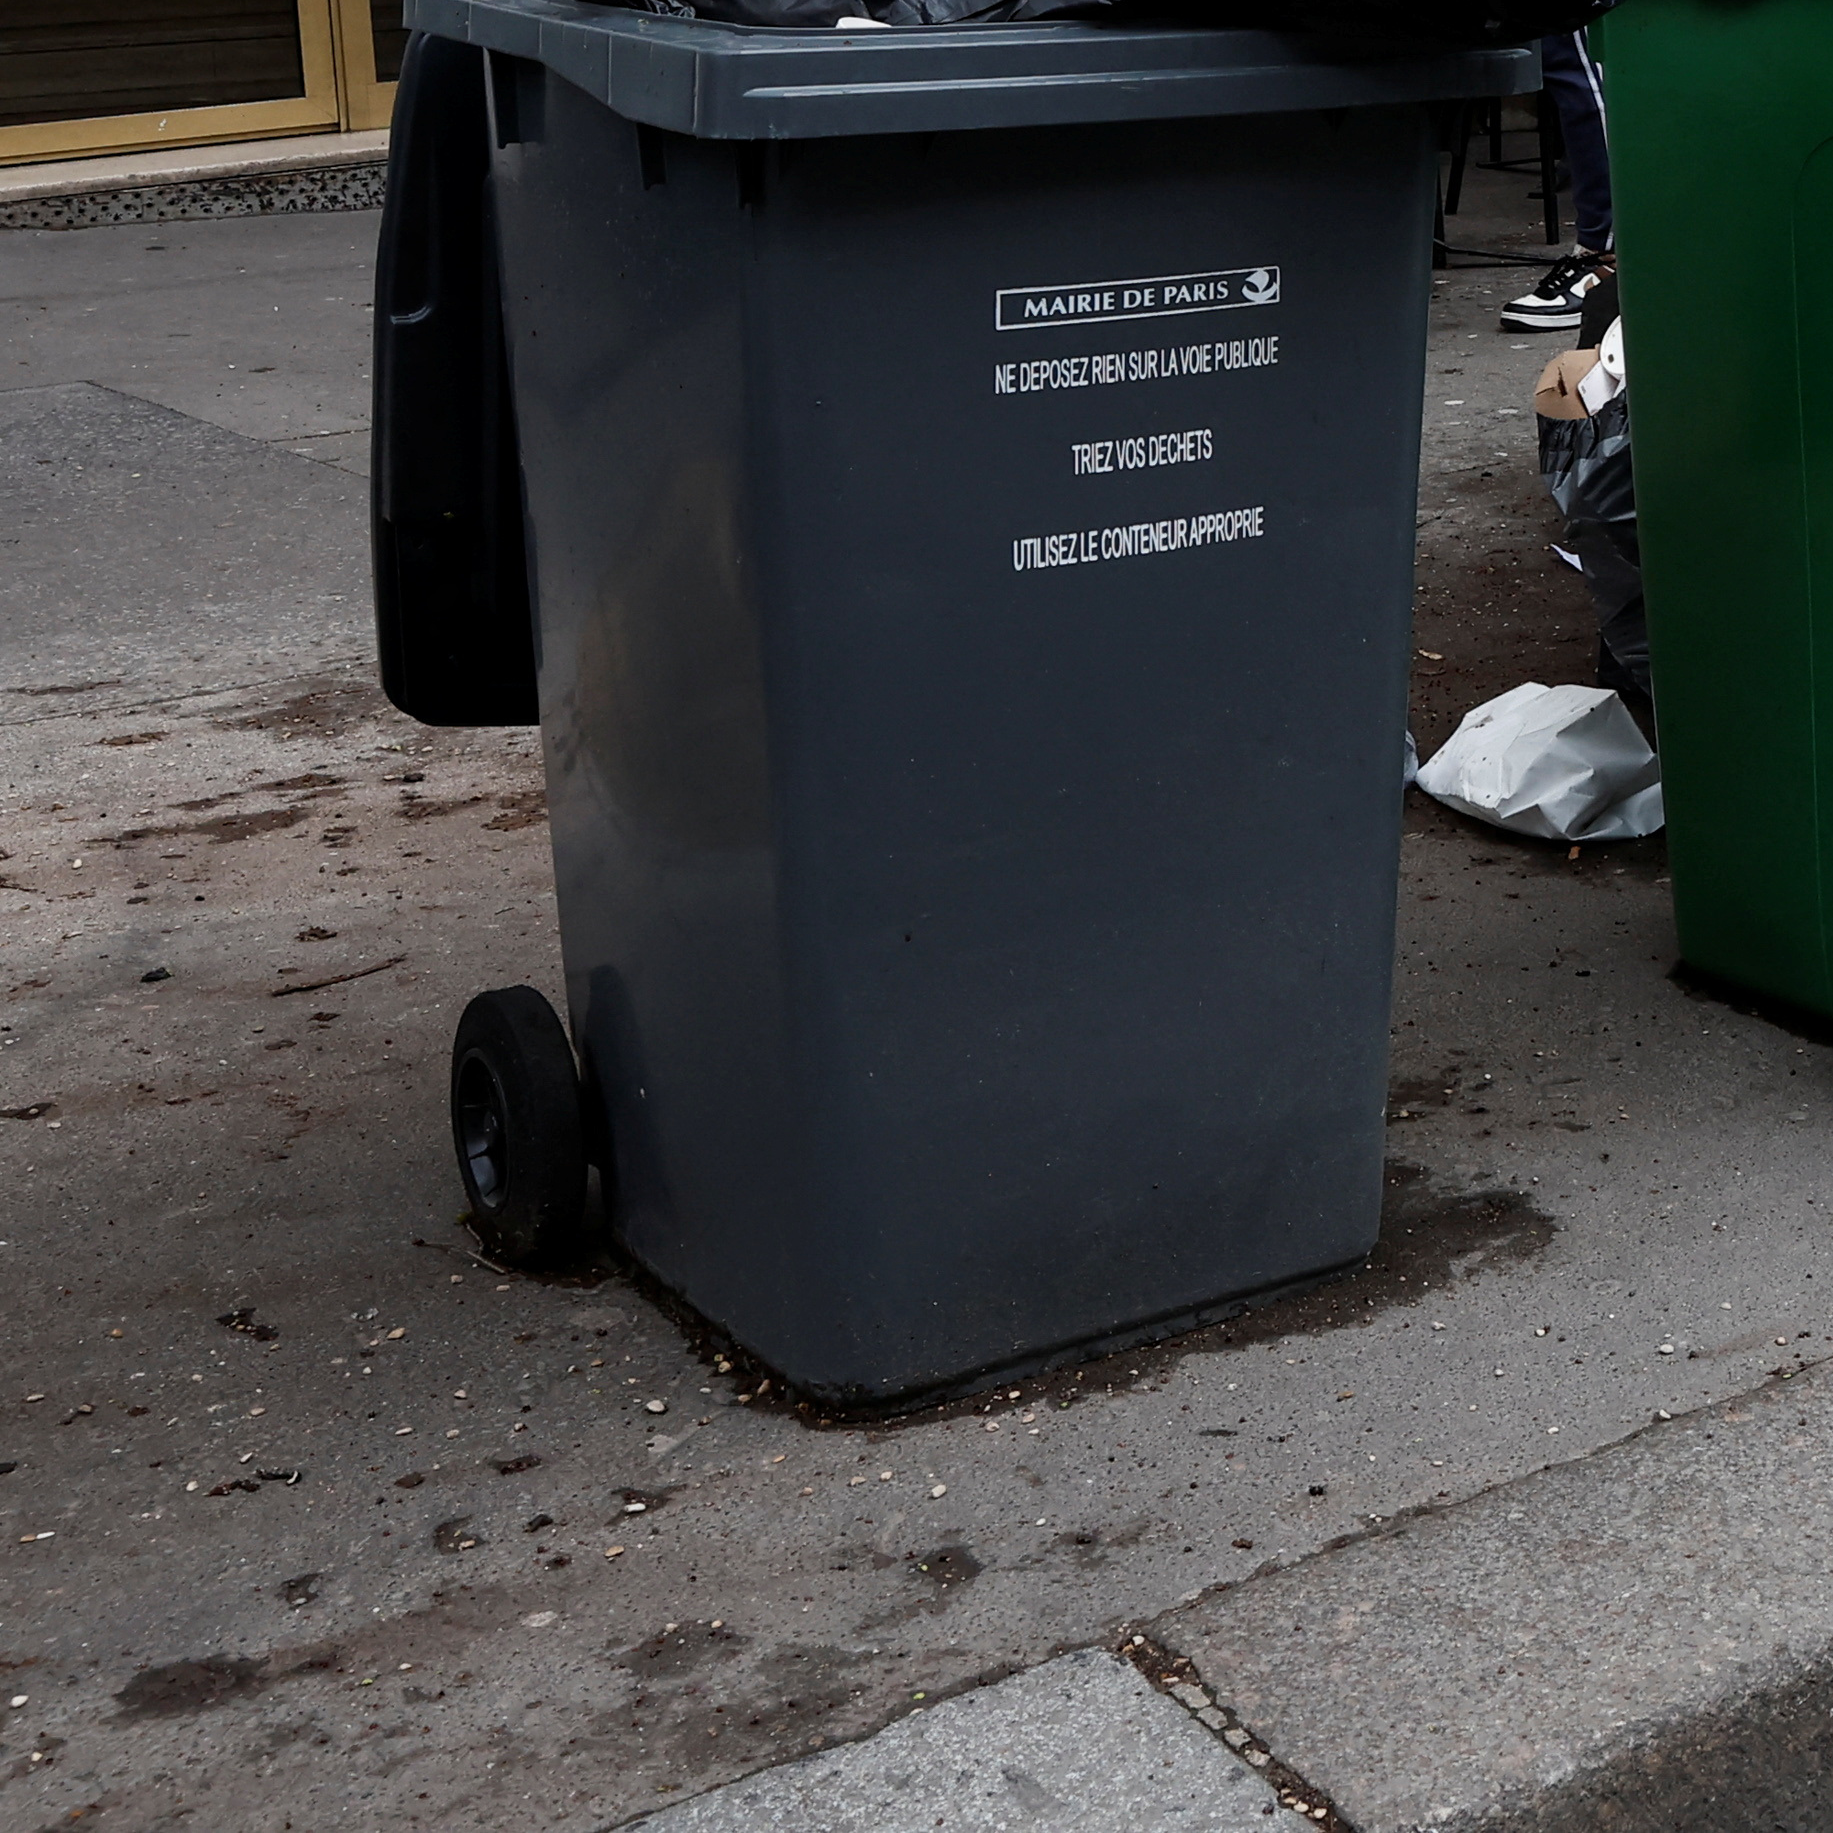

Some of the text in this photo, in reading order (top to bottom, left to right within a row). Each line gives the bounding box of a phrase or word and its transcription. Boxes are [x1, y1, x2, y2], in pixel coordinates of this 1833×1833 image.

[1024, 281, 1229, 318] MAIRIE DE PARIS
[995, 336, 1279, 394] NE DEPOSEZ RIEN SUR LA VOIE PUBLIQUE
[1071, 428, 1213, 475] TRIEZ VOS DECHETS
[1012, 506, 1264, 571] UTILISEZ LE CONTENEUR APPROPRIE
